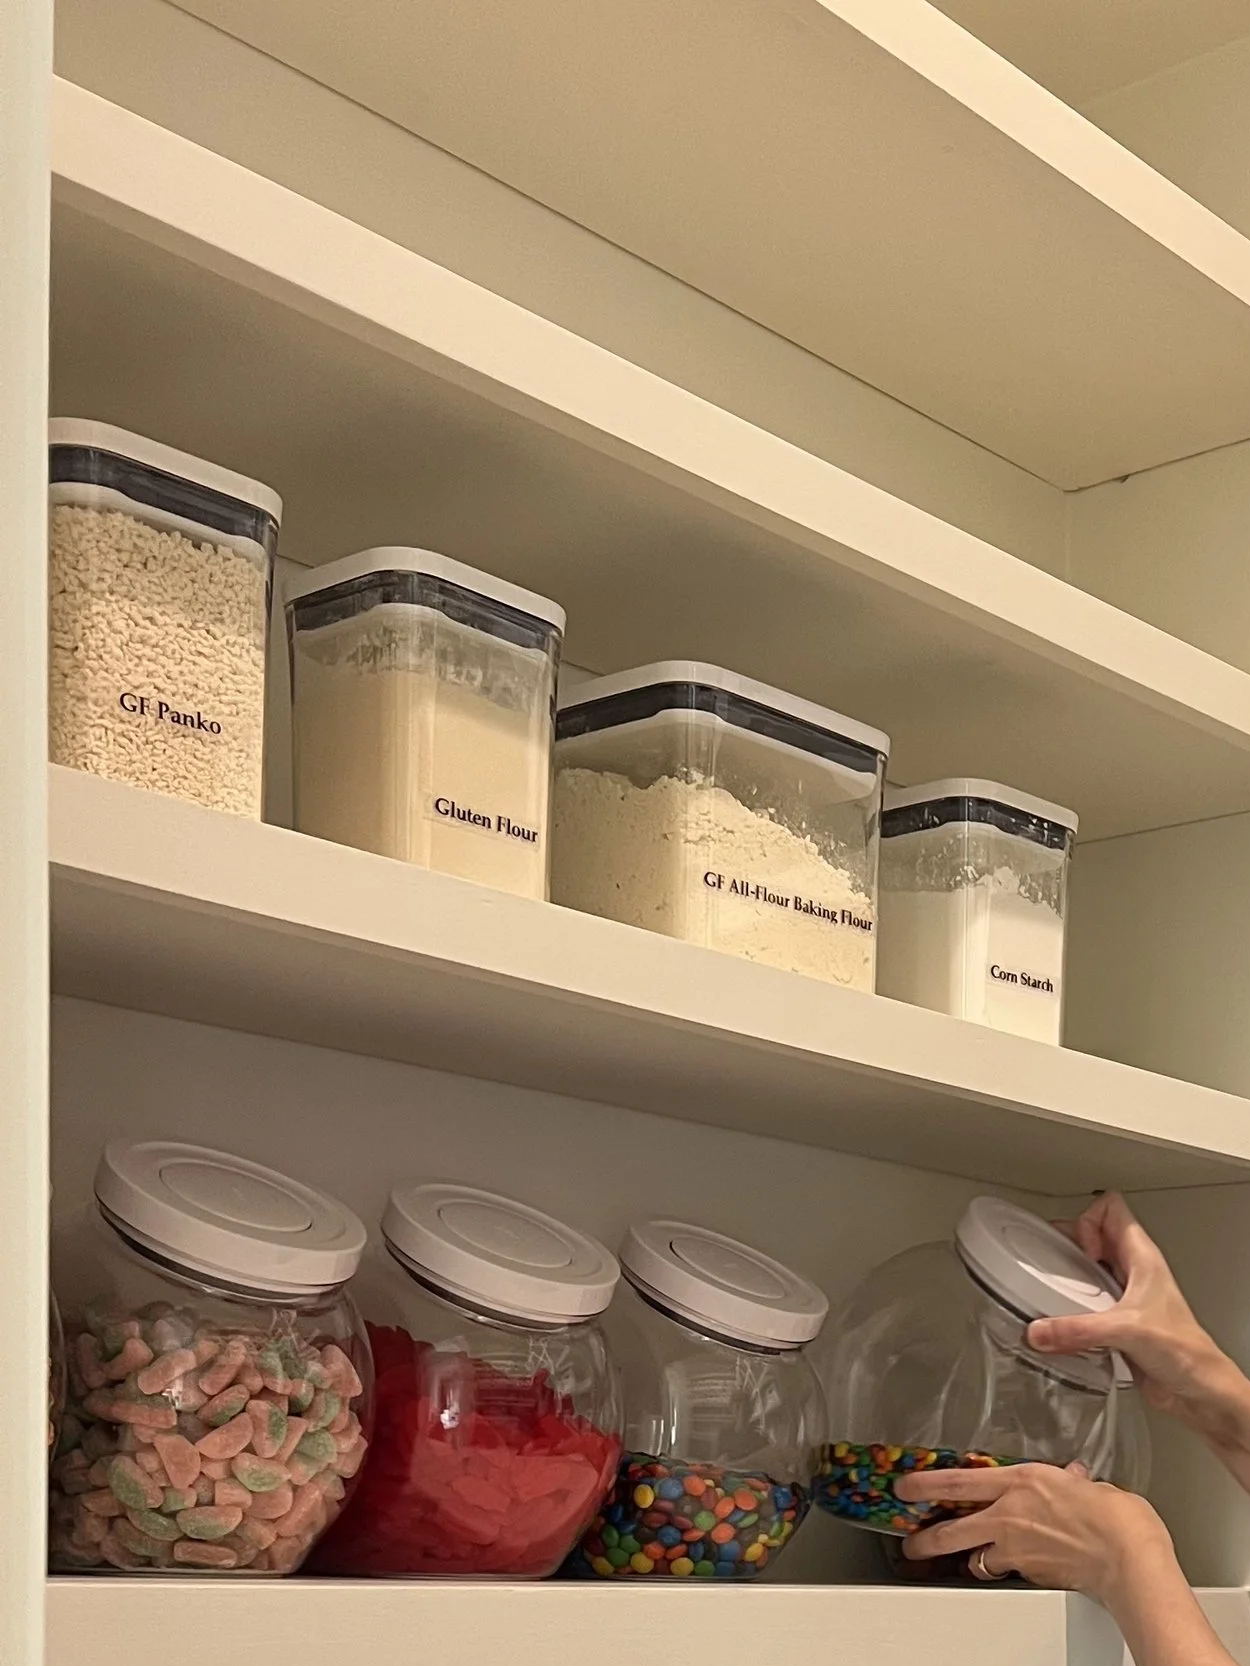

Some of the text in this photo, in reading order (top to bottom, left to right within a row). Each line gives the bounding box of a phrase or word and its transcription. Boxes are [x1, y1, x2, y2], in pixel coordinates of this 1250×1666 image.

[119, 692, 222, 735] GF Panko
[434, 797, 538, 843] Gluten Flour
[703, 871, 873, 931] GF All-Flour Baking Flour
[990, 964, 1054, 993] Corn Starch
